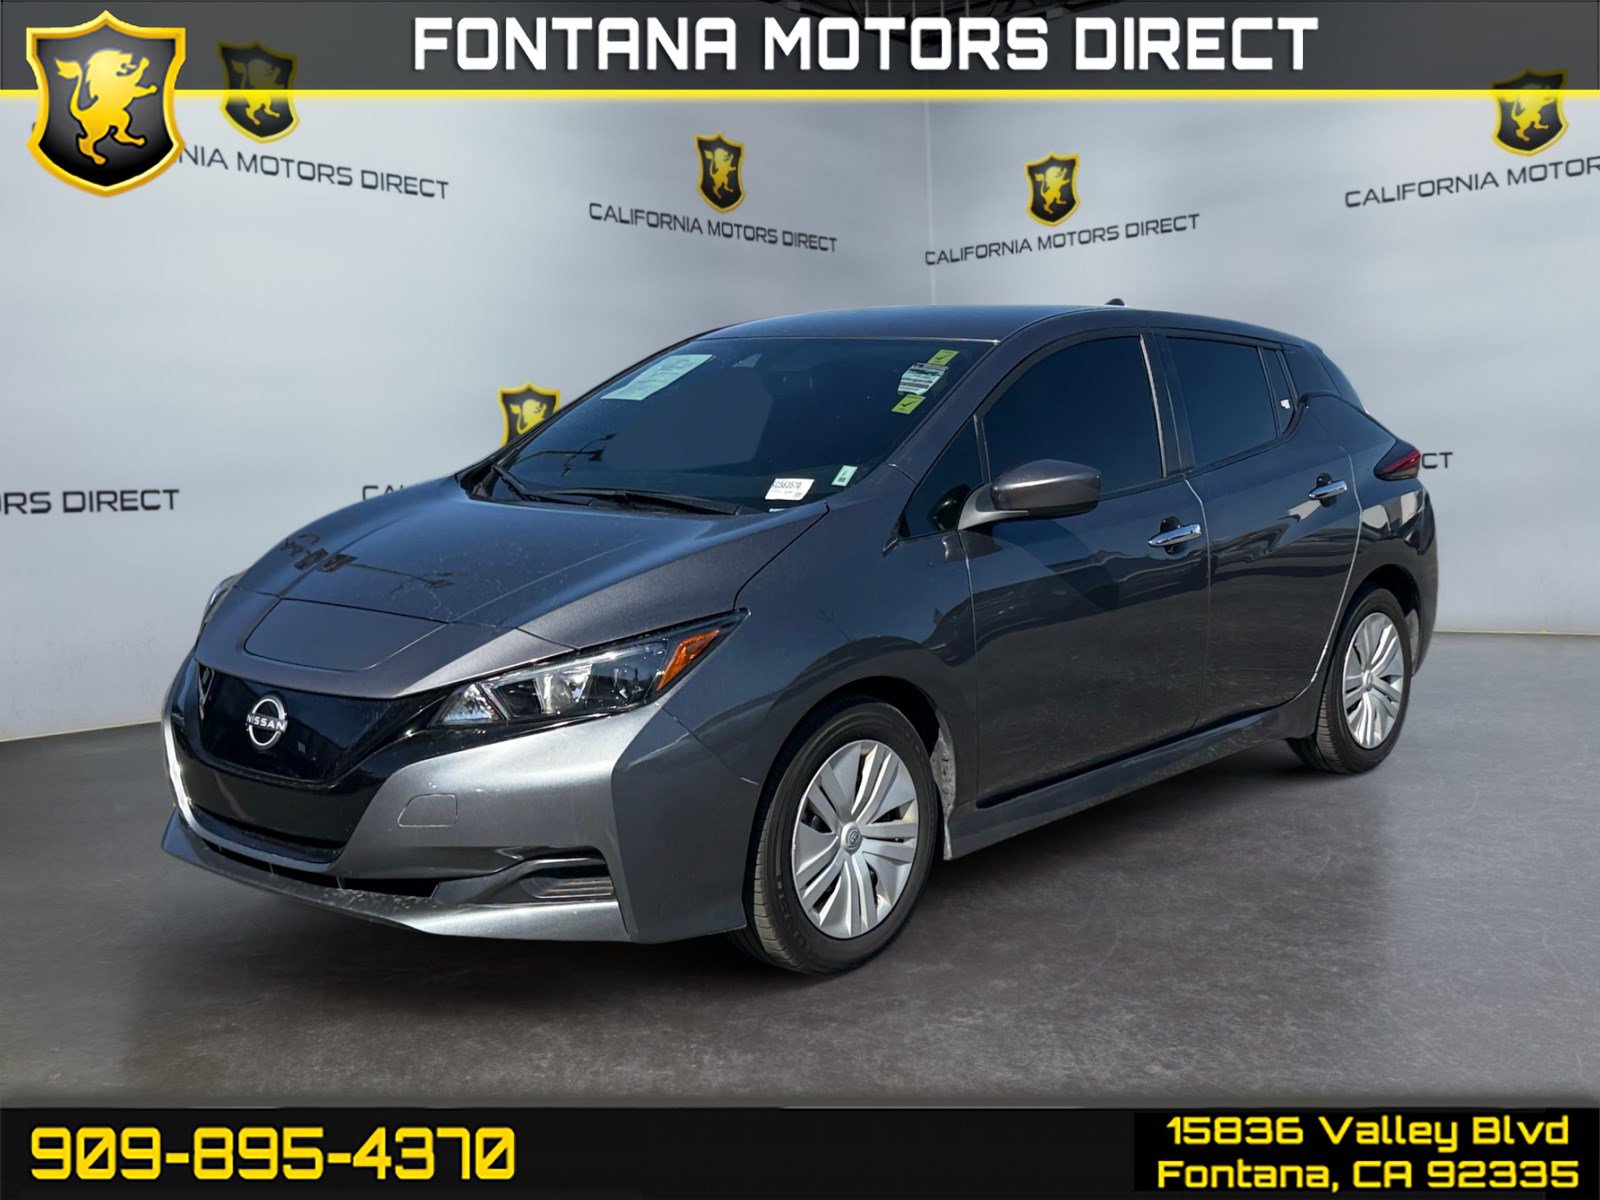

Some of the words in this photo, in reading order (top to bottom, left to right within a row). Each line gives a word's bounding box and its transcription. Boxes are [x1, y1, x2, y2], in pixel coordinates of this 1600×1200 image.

[237, 151, 353, 187] MOTORS
[361, 170, 449, 199] DIRECT
[1345, 170, 1500, 208] CALIFORNIA
[589, 202, 703, 234] CALIFORNIA
[707, 219, 779, 245] MOTORS
[782, 230, 837, 252] DIRECT
[925, 238, 1033, 266] CALIFORNIA
[1037, 225, 1120, 251] MOTORS
[1125, 213, 1200, 239] DIRECT
[0, 491, 52, 515] RS
[62, 489, 180, 513] DIRECT
[246, 714, 287, 732] NISSAN
